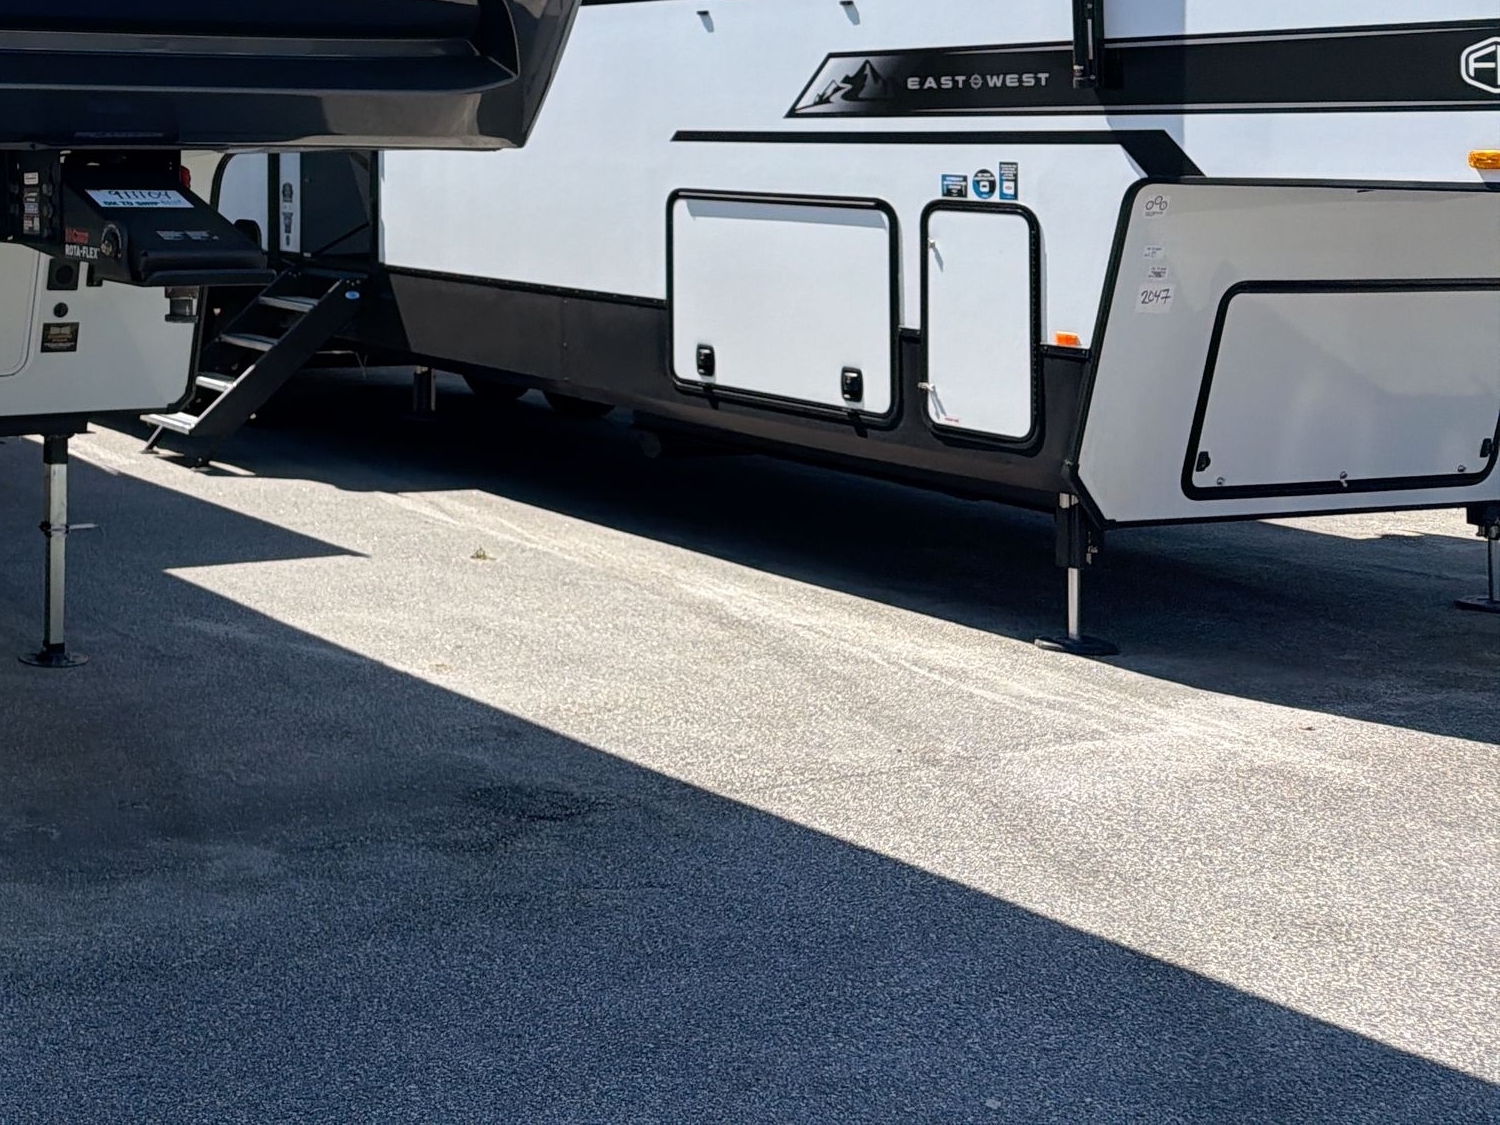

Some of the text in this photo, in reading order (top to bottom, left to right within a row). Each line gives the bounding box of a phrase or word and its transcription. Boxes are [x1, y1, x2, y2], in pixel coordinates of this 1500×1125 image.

[906, 72, 1050, 90] EAST WEST
[1141, 288, 1171, 305] 2047
